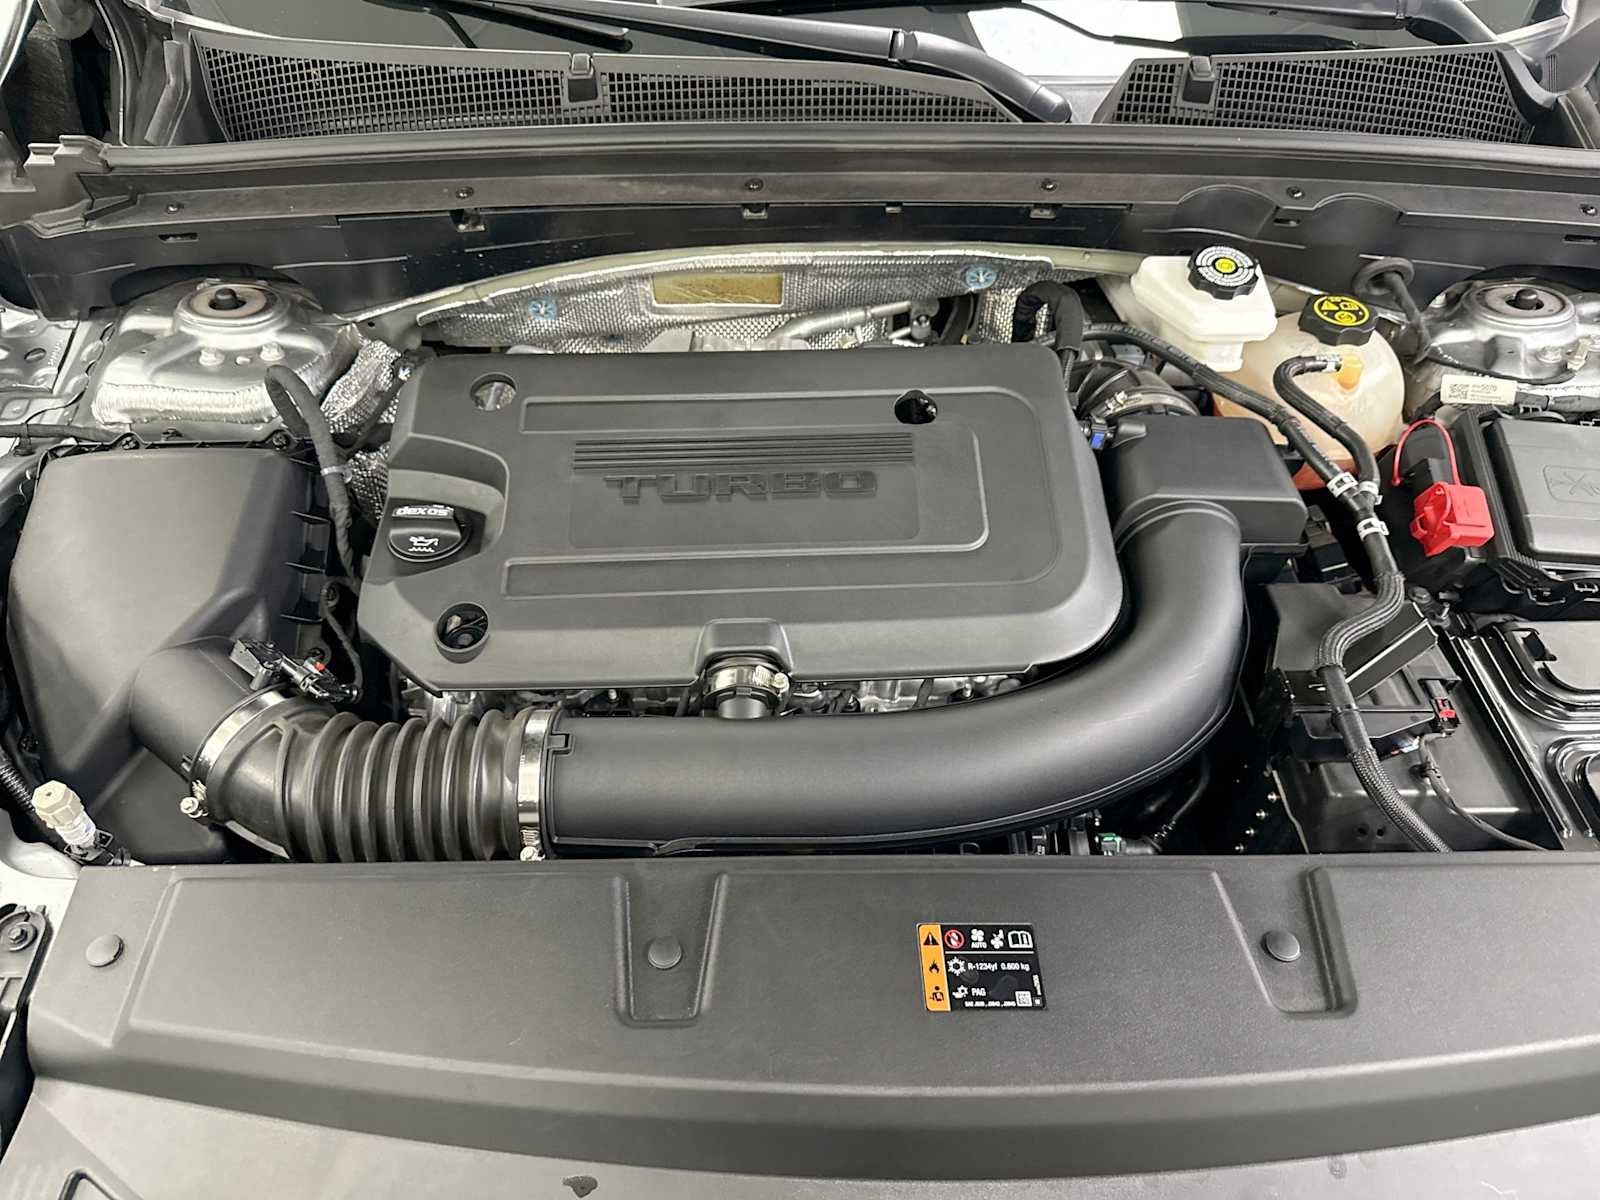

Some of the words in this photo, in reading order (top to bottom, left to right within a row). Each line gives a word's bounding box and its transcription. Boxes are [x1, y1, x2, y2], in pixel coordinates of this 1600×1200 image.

[604, 471, 877, 504] TURBO
[396, 506, 448, 516] dexos
[1020, 962, 1030, 972] kg
